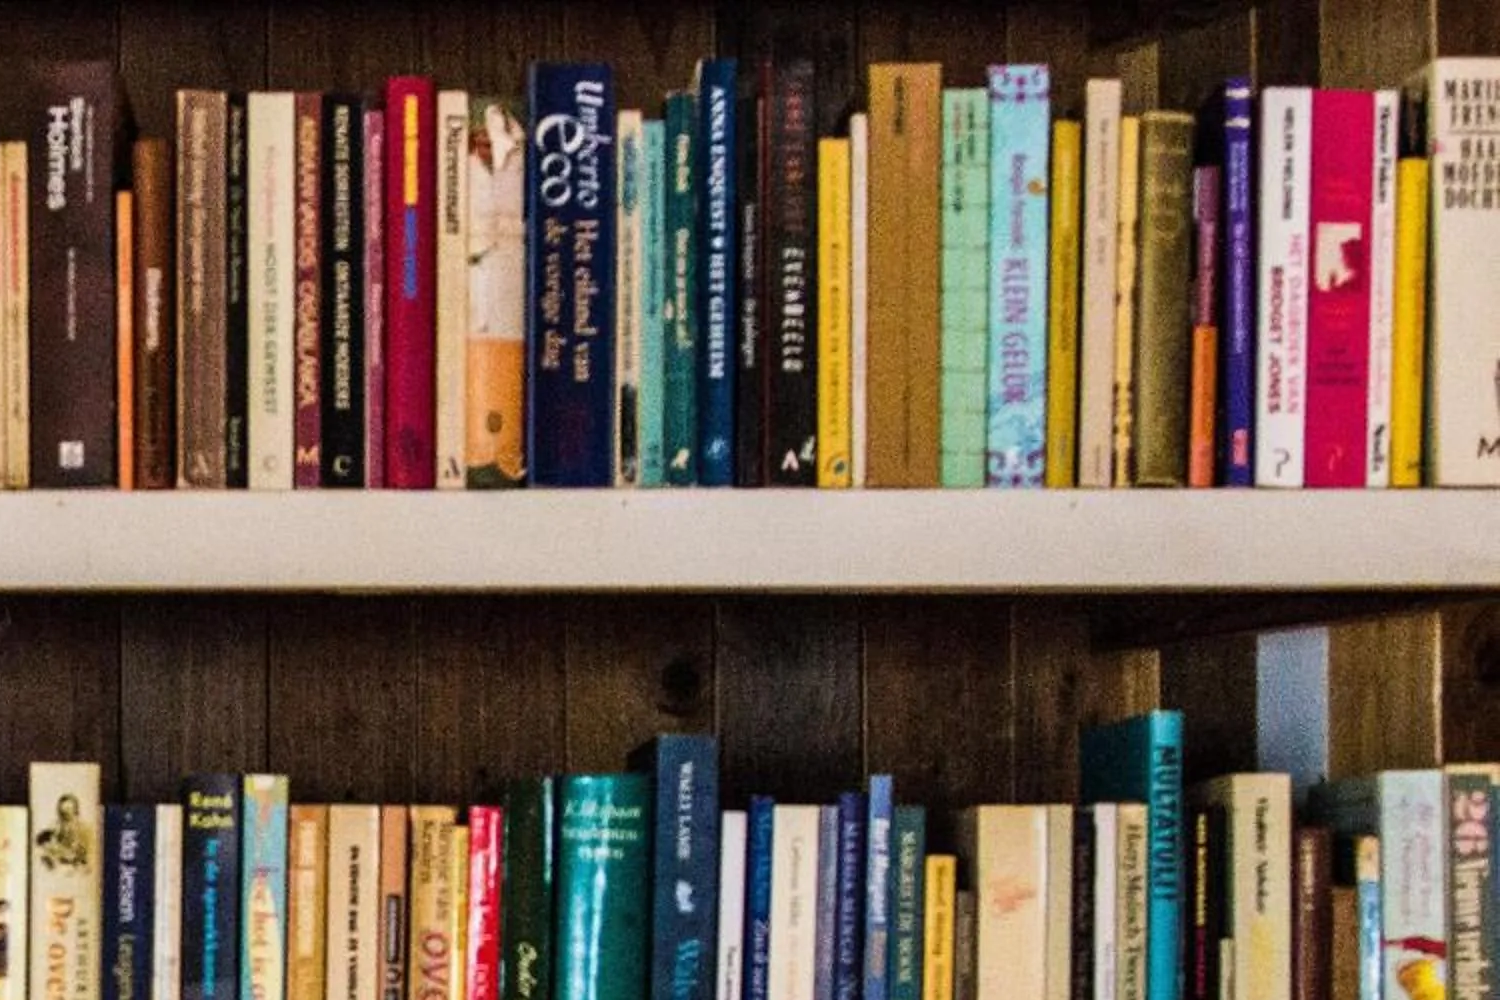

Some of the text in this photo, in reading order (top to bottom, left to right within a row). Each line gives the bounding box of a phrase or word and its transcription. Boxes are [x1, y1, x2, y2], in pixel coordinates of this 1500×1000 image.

[574, 81, 611, 209] Umberto
[709, 87, 726, 140] ANNA
[46, 107, 70, 211] Holmes
[708, 144, 726, 230] ENQUIST
[543, 217, 565, 244] de
[574, 217, 600, 383] Het eiland van
[709, 253, 726, 292] HET
[298, 281, 318, 410] CASABLANCA
[1001, 332, 1028, 406] GELUK
[1266, 266, 1284, 415] BRIDGET JONES
[1454, 791, 1488, 857] 26
[49, 898, 74, 938] De
